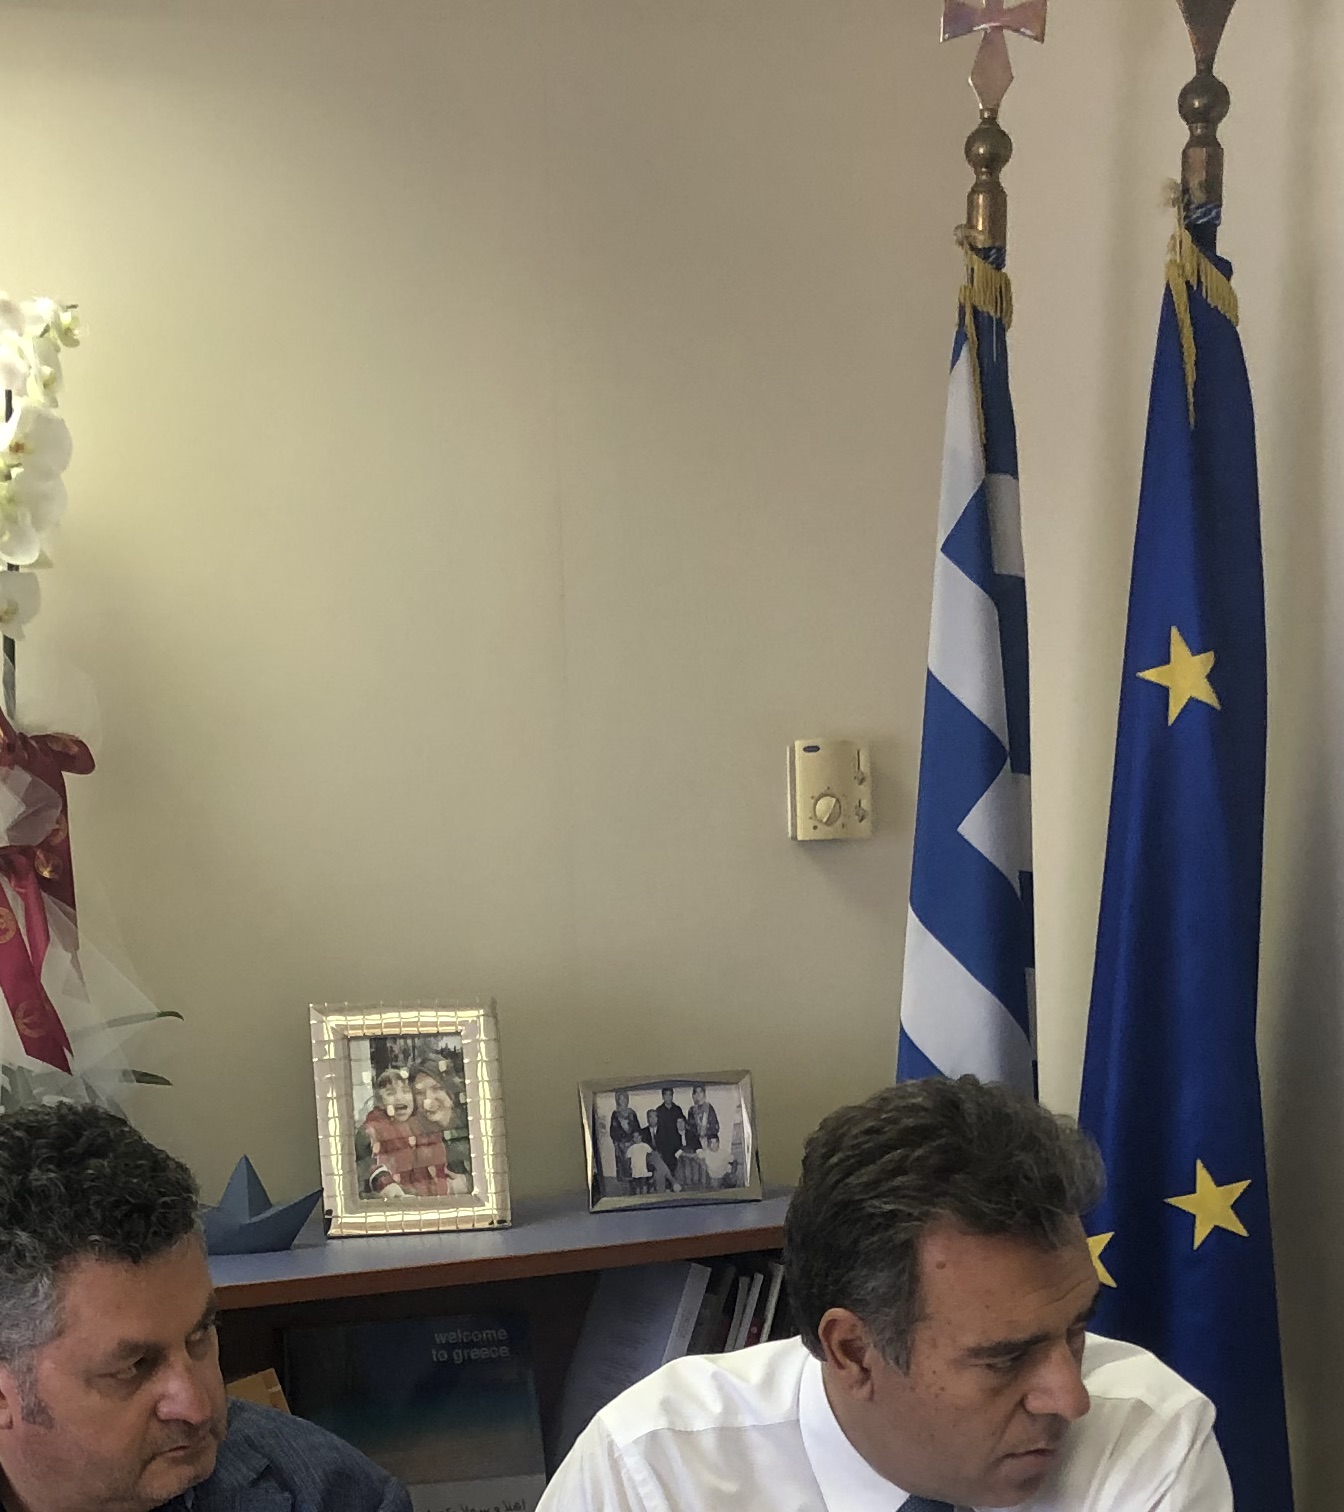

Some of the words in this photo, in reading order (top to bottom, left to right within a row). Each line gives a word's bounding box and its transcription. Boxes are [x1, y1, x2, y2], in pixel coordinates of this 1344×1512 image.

[434, 1328, 508, 1345] welcome
[431, 1348, 449, 1362] to
[452, 1345, 510, 1365] greece
